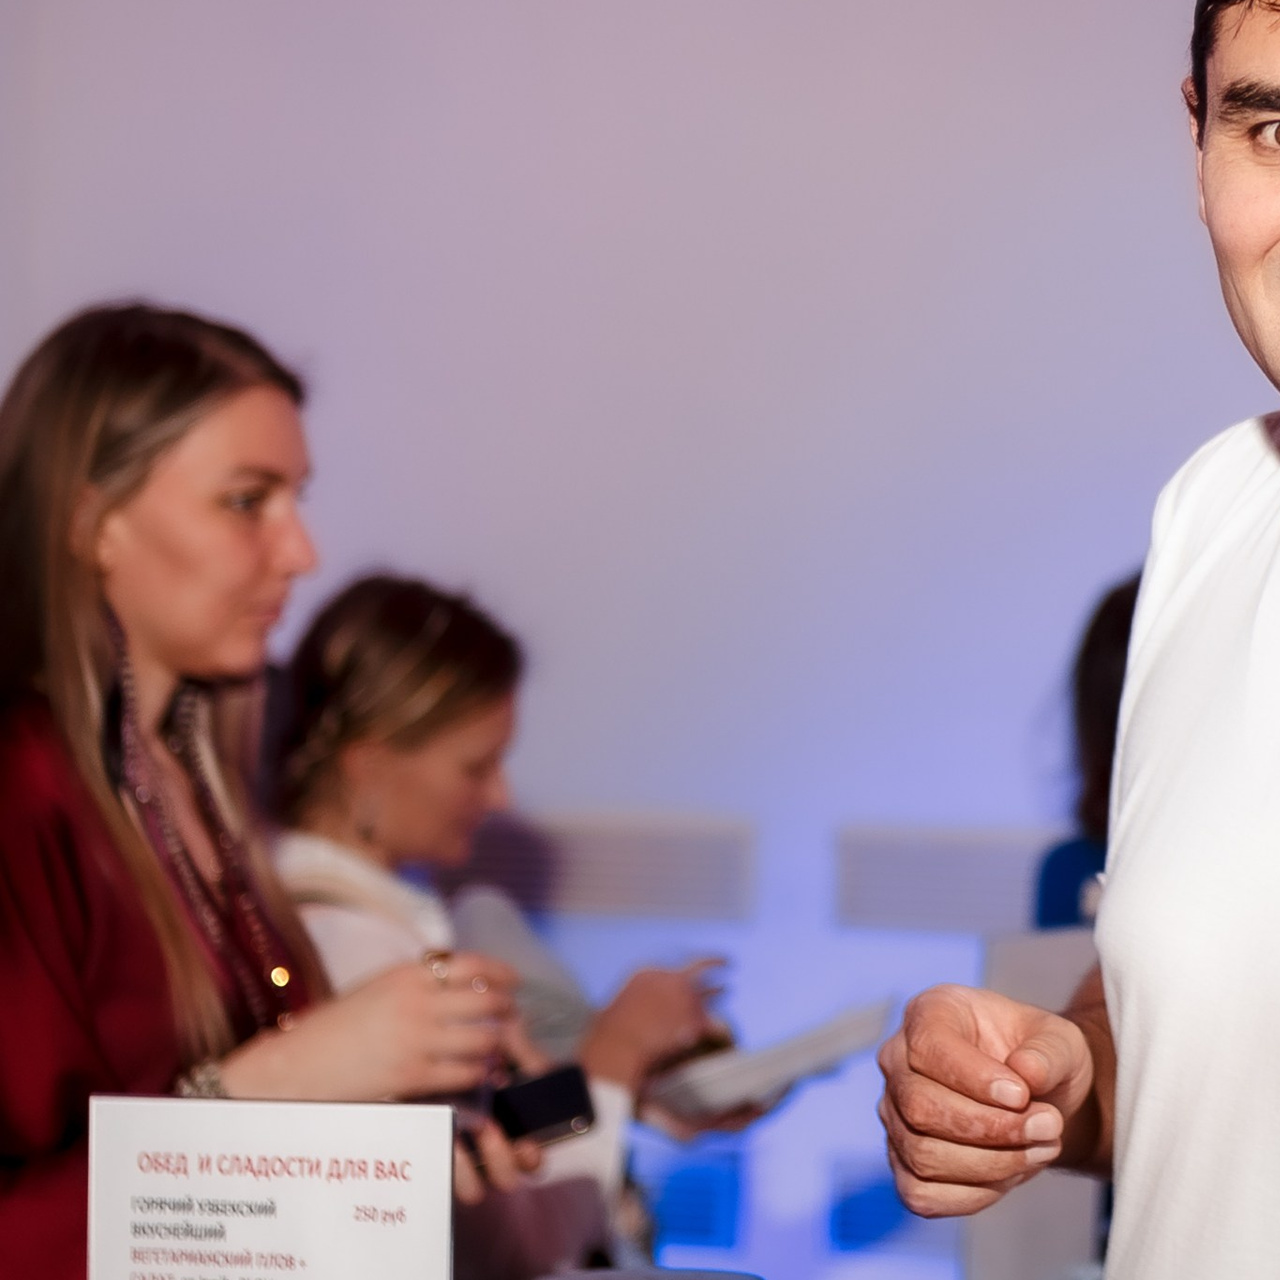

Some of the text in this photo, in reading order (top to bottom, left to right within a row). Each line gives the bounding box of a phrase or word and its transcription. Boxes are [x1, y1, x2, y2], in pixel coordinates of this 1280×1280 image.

[137, 1151, 412, 1184] ОБЕД И СЛАДОСТИ ДЛЯ ВАС
